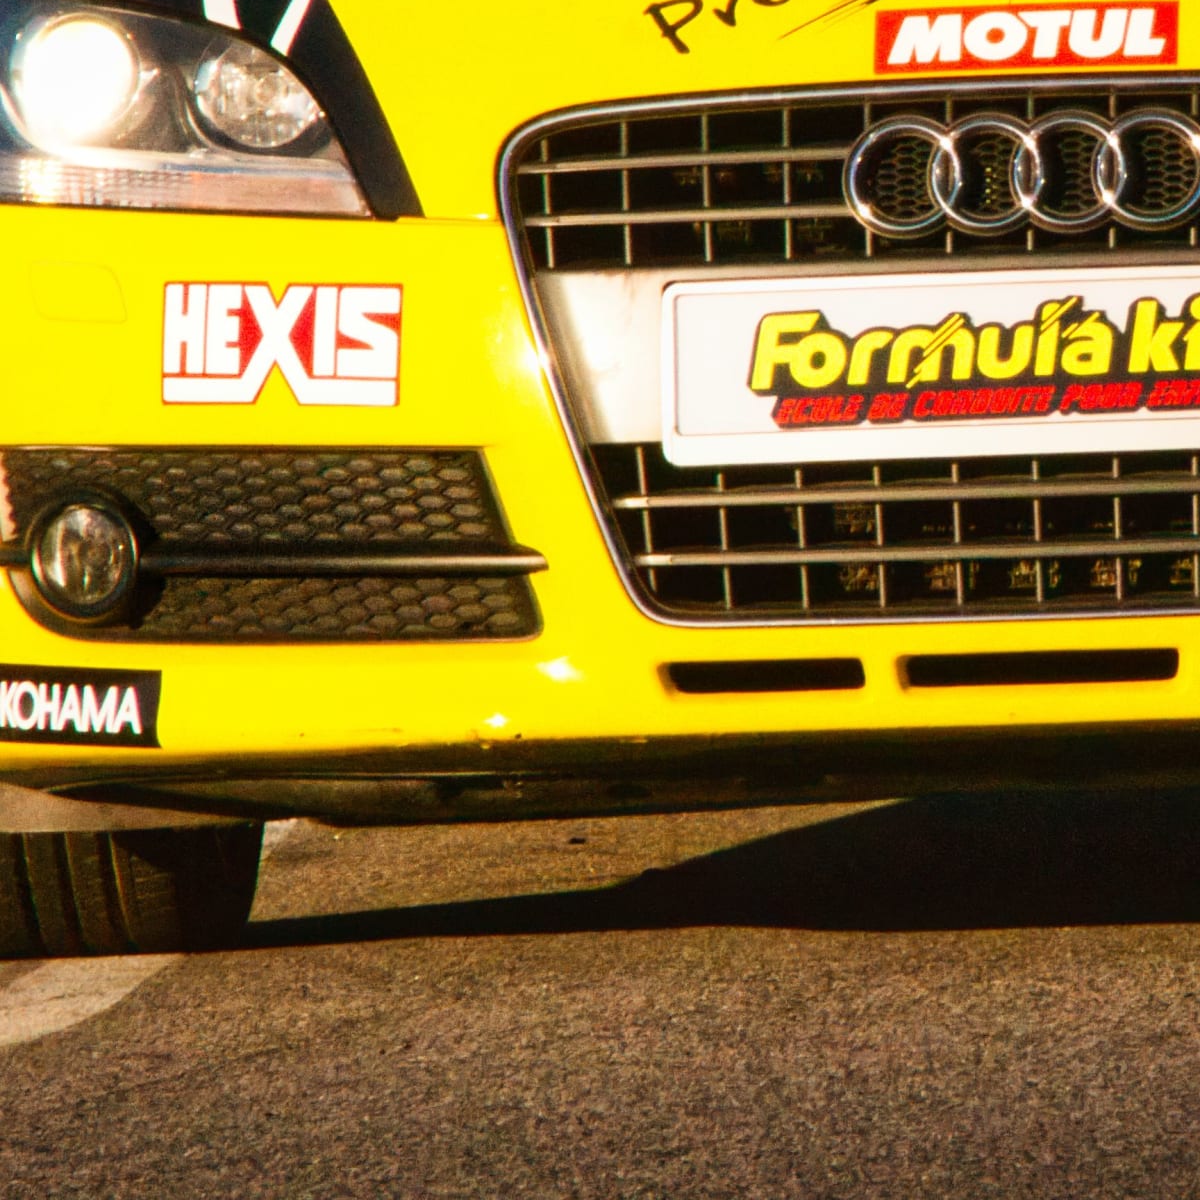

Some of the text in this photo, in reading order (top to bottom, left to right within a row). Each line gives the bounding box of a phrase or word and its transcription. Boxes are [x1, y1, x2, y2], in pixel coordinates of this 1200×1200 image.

[887, 6, 1168, 65] MOTUL
[162, 281, 403, 407] HEXIS
[751, 295, 1112, 390] Formula
[0, 679, 143, 735] KOHAMA
